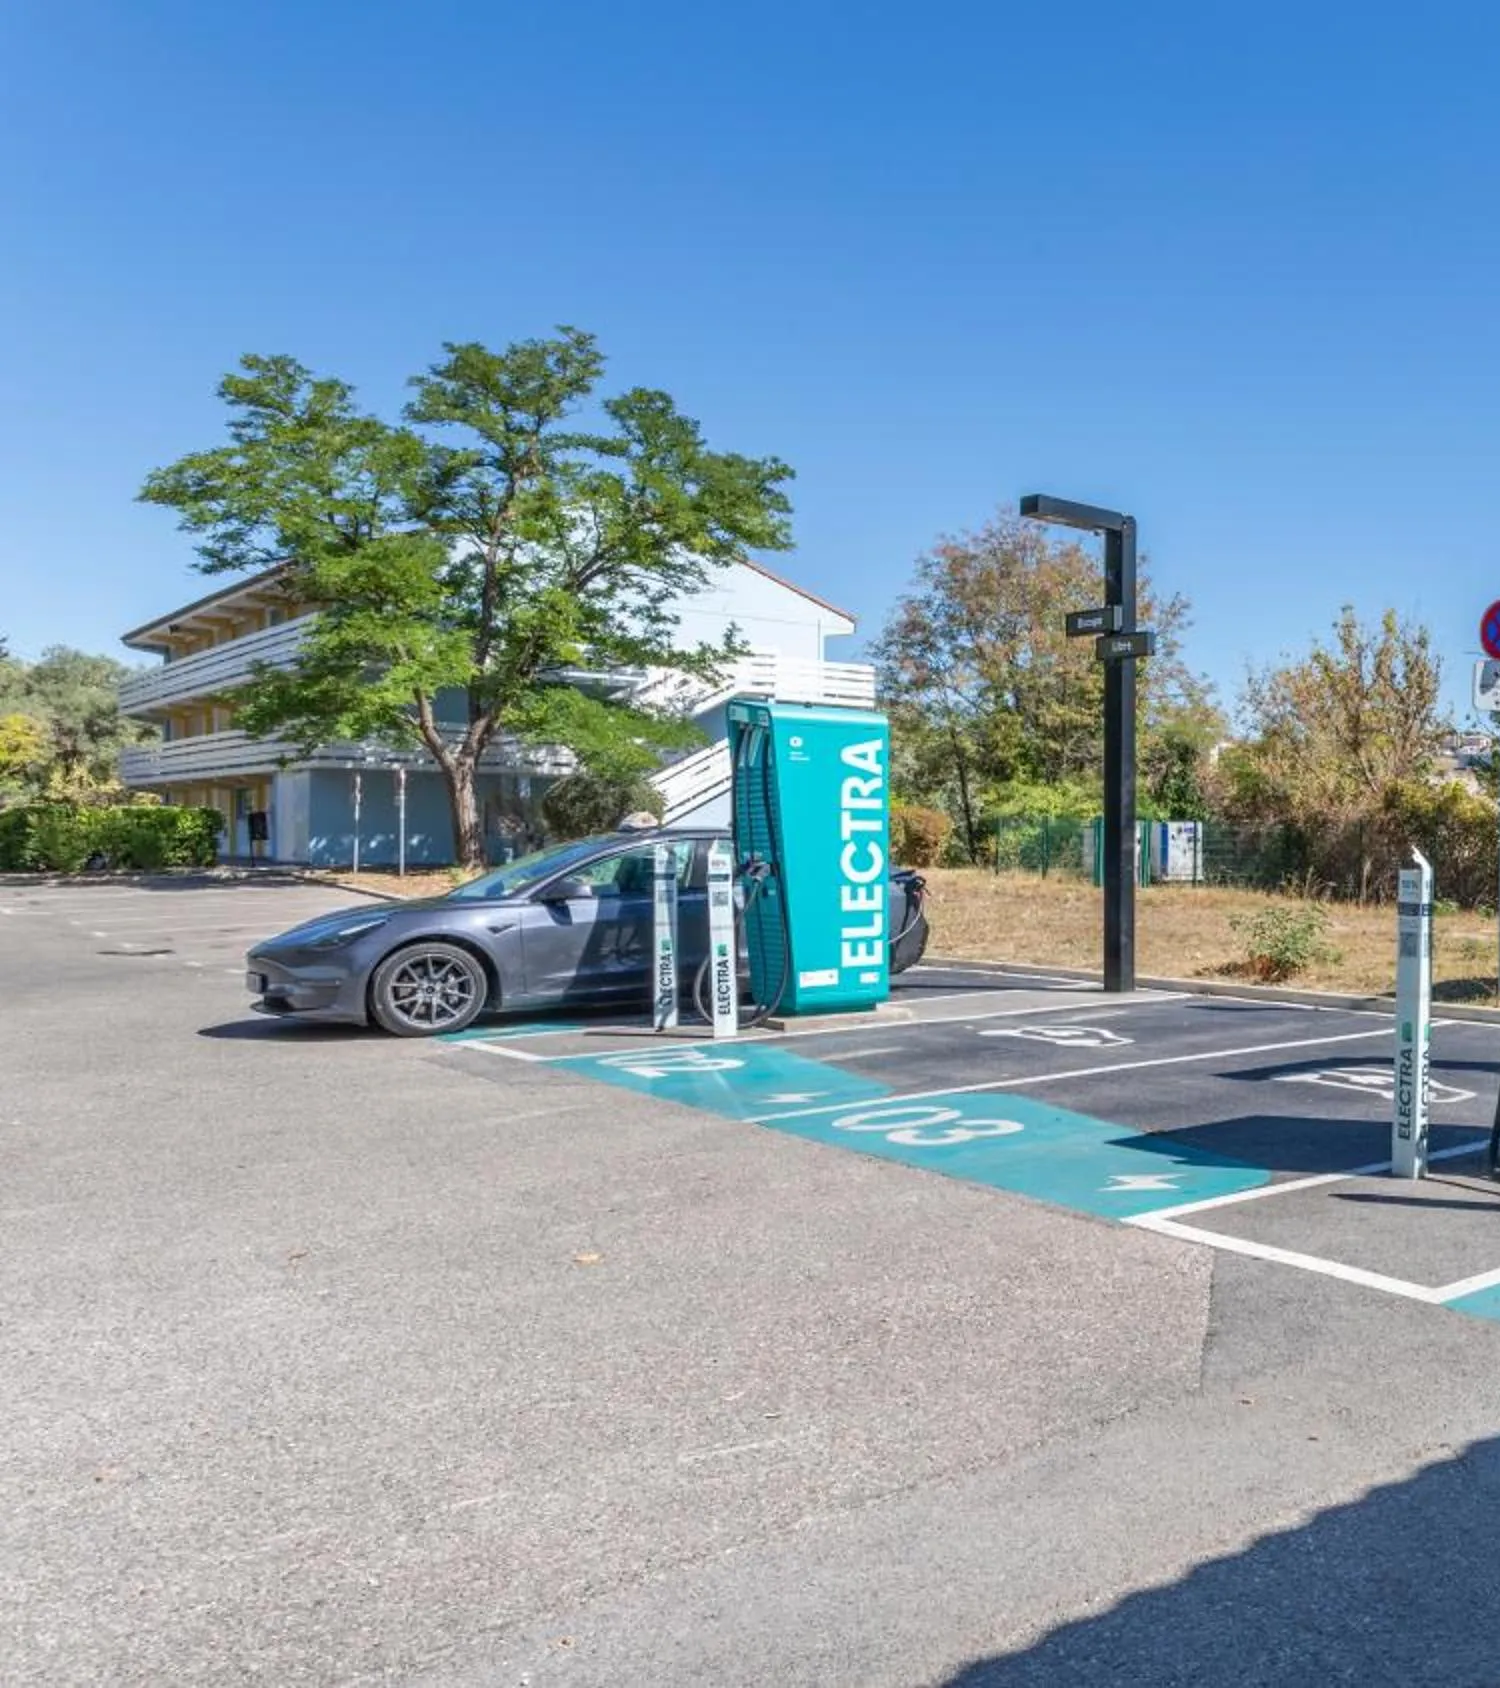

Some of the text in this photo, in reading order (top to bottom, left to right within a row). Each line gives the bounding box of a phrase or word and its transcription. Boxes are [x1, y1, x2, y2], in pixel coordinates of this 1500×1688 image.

[840, 738, 884, 967] ELECTRA
[717, 959, 731, 1015] ELECTRA
[831, 1106, 1025, 1146] 03
[1398, 1048, 1413, 1140] ELECTRA
